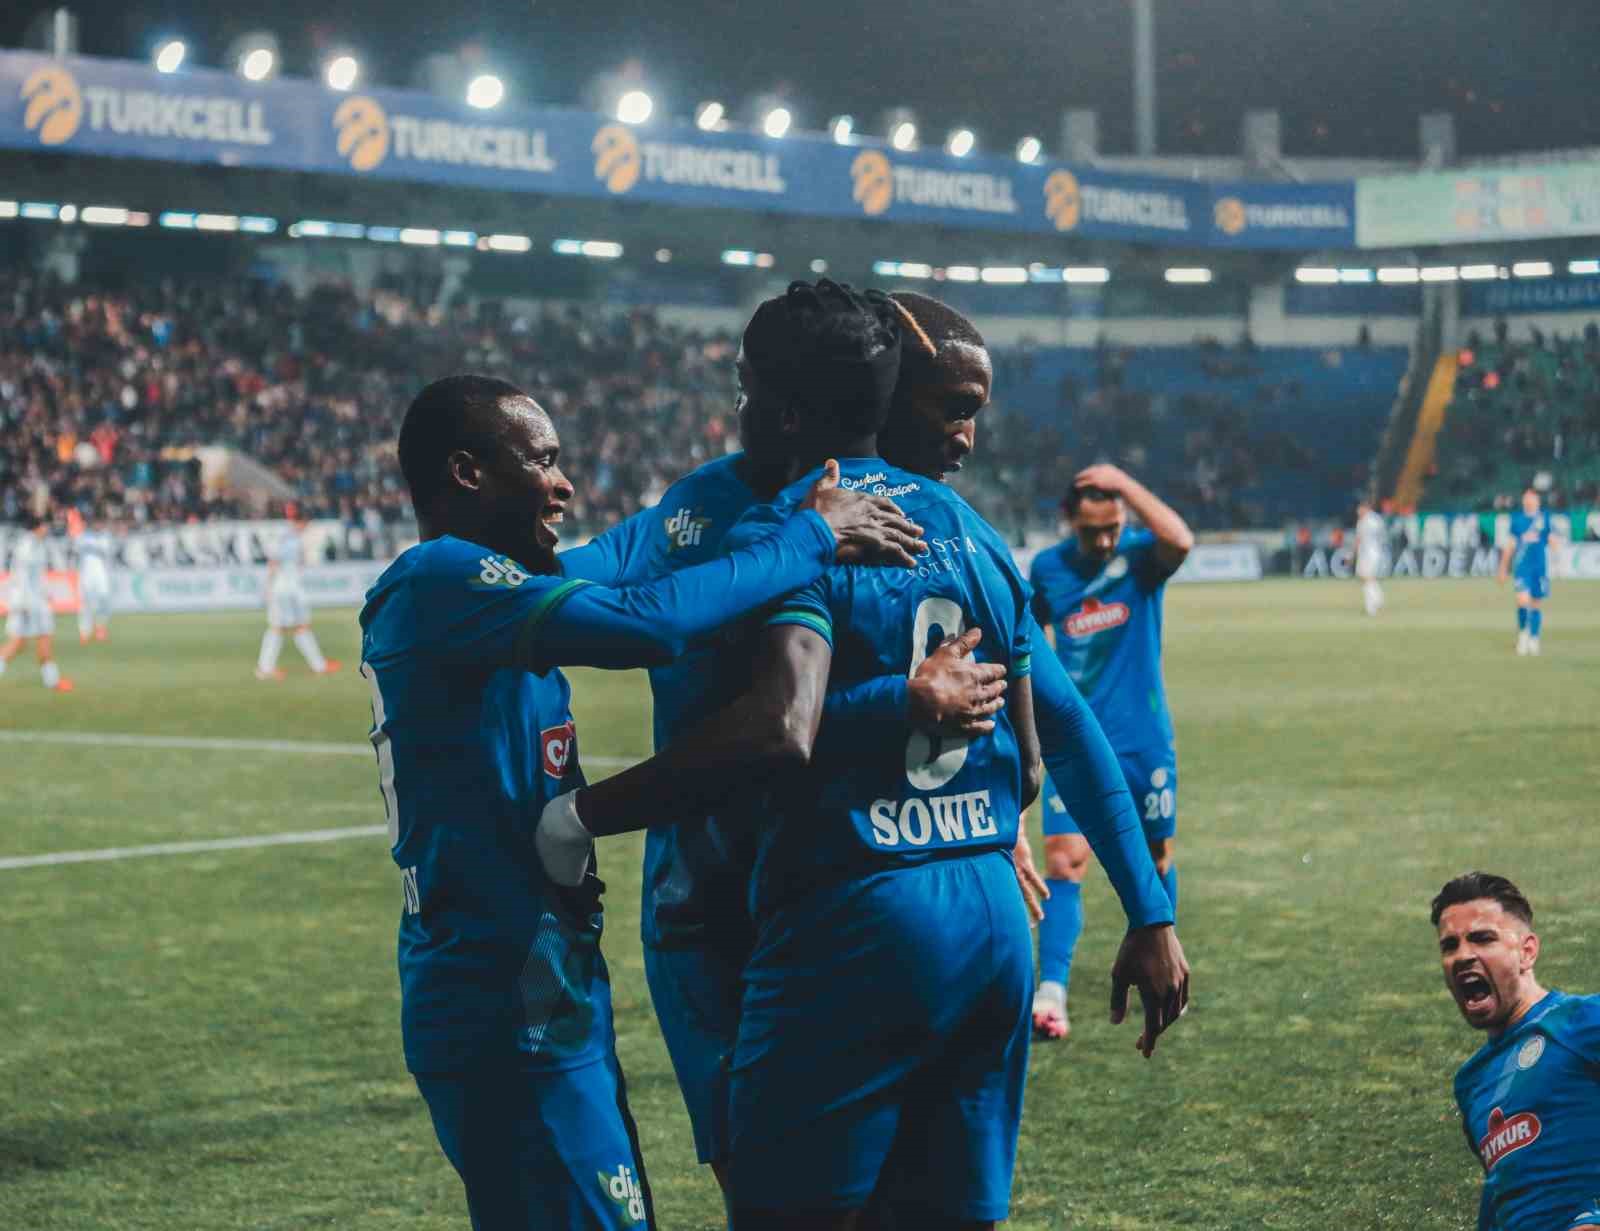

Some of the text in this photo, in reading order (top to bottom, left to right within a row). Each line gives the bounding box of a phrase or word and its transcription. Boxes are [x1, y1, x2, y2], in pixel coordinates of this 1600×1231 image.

[88, 88, 272, 146] TURKCELL
[391, 116, 556, 172] TURKCELL
[643, 144, 787, 193] TURKCELL
[893, 166, 1017, 213] TURKCELL
[1080, 185, 1188, 230] TURKCELL
[1247, 203, 1347, 228] TURKCELL
[1303, 550, 1500, 578] ACADEM
[870, 790, 998, 845] SOWE
[1144, 789, 1173, 820] 20
[1481, 1120, 1532, 1165] AYKUR
